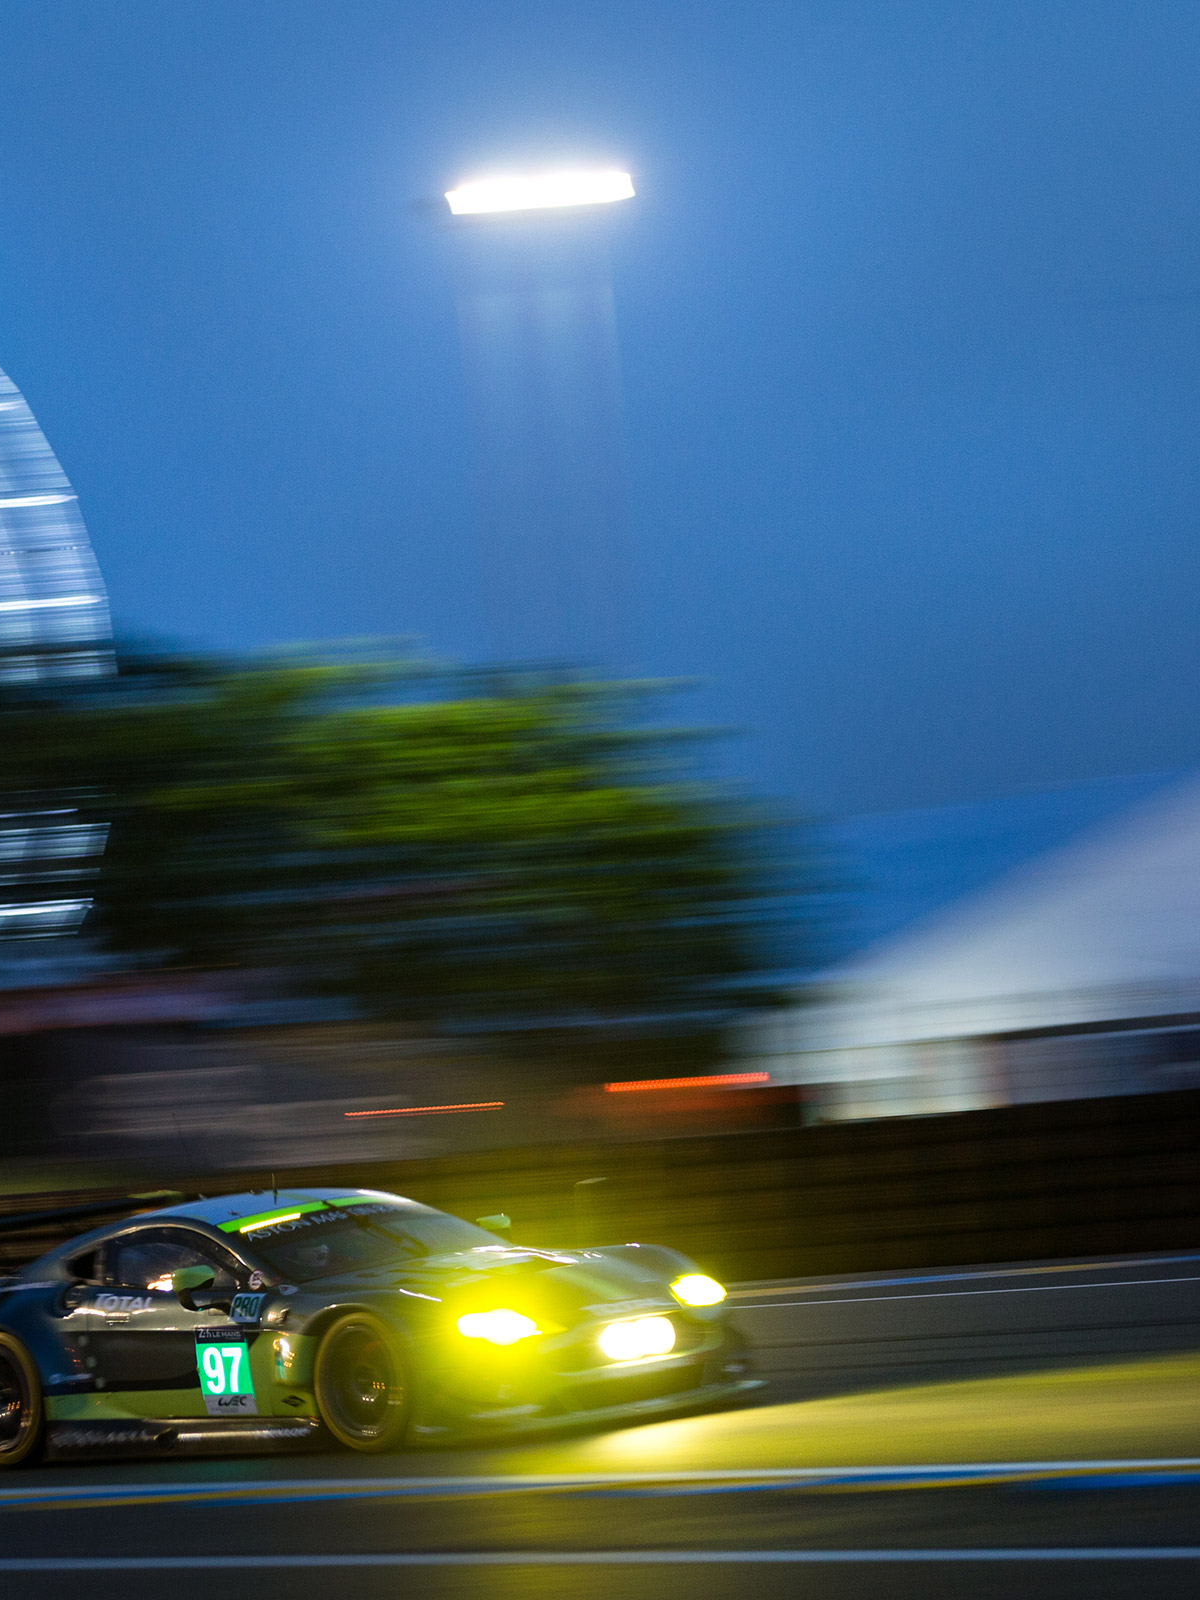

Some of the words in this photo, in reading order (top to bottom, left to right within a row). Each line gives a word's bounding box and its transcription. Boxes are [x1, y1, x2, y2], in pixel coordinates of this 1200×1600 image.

[247, 1218, 312, 1242] ASTON
[94, 1293, 153, 1311] TOTAL
[231, 1296, 260, 1318] PRO
[202, 1347, 242, 1394] 97
[218, 1396, 247, 1407] WEC
